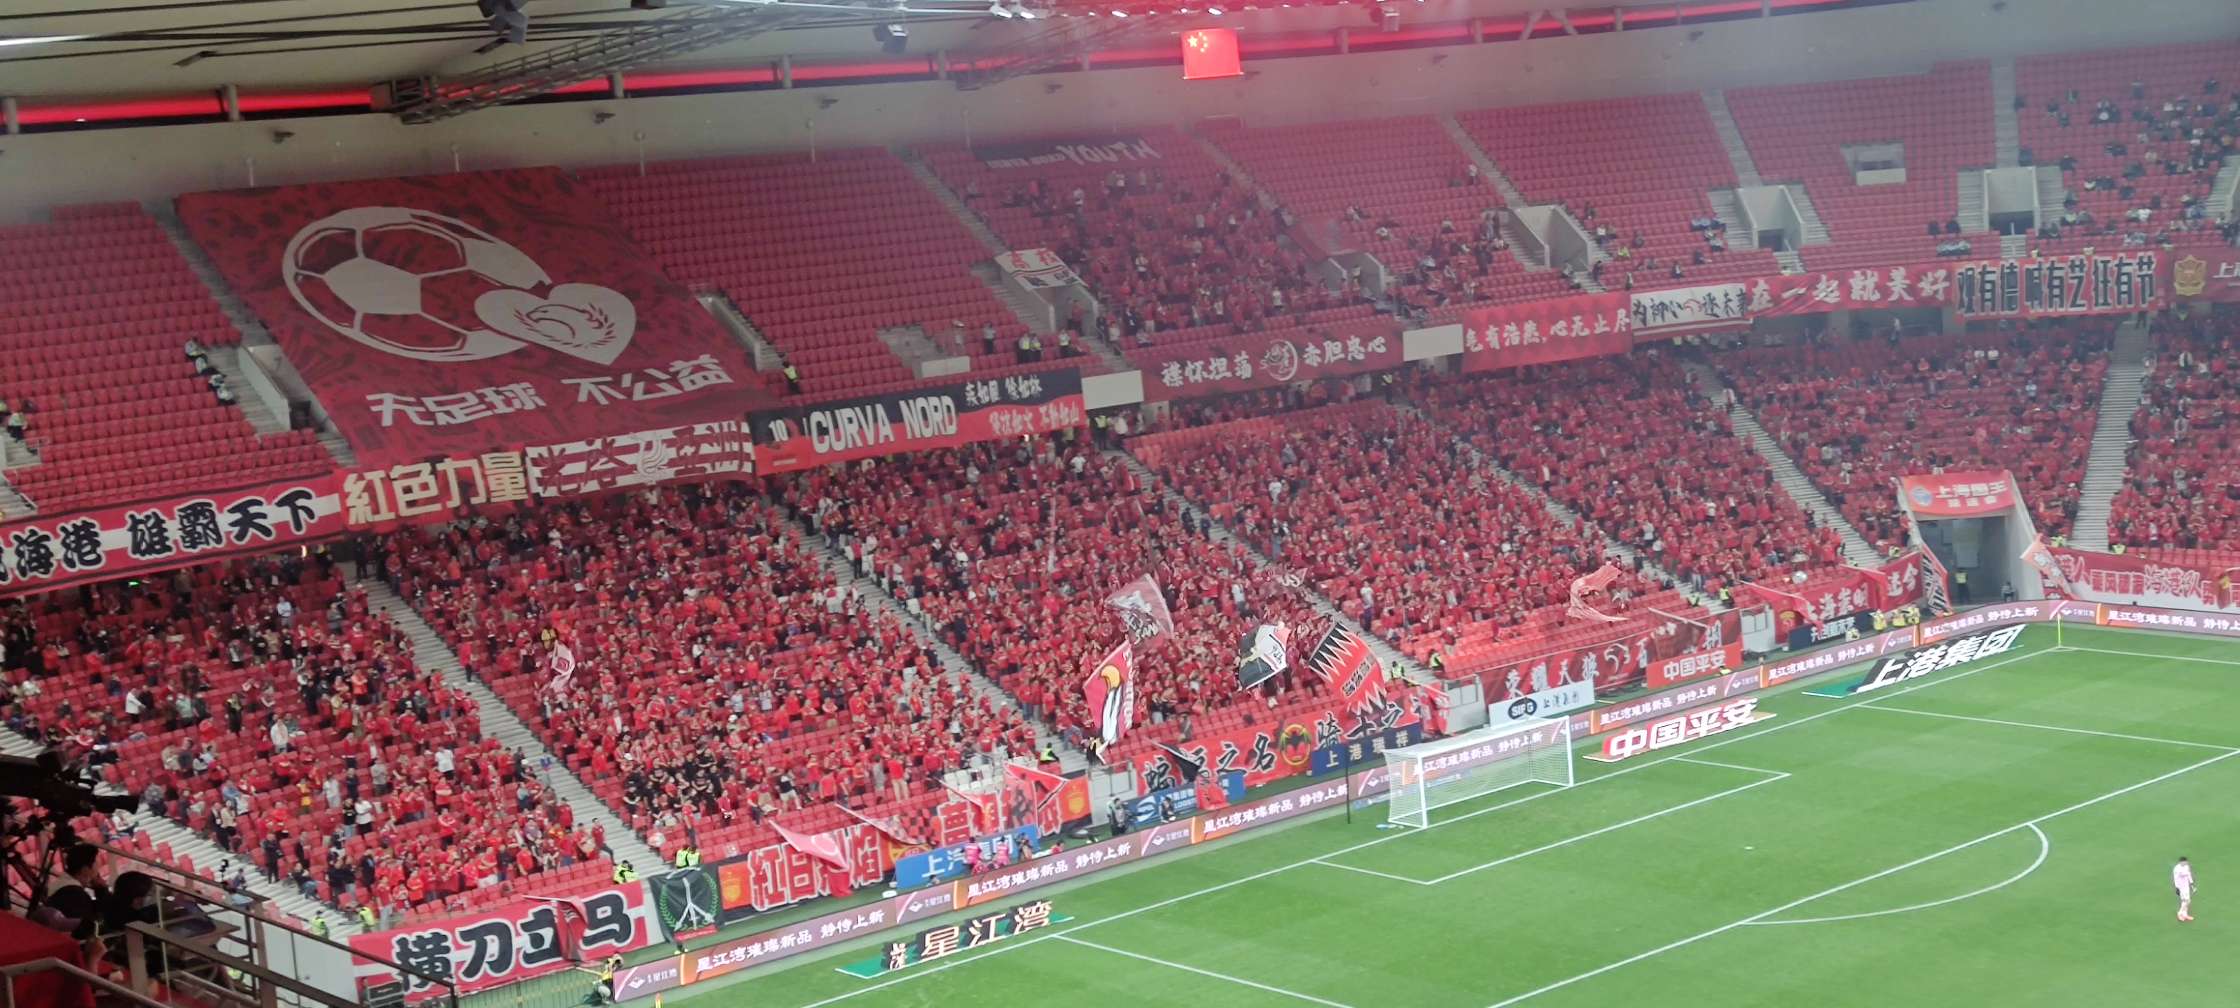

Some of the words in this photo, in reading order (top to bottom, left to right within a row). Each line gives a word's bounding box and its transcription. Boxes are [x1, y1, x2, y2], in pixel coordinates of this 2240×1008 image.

[1748, 266, 1949, 311] 在一起就美好
[366, 382, 546, 426] 无足球
[561, 354, 733, 406] 不公益
[810, 403, 895, 454] CURVA
[899, 395, 957, 440] NORD
[0, 519, 103, 583] 海港
[127, 488, 319, 558] 雄霸天下
[1663, 649, 1727, 681] 中国平安
[1856, 624, 2027, 693] 上港集团
[1609, 698, 1758, 757] 中国平安
[921, 901, 1053, 963] 星江湾
